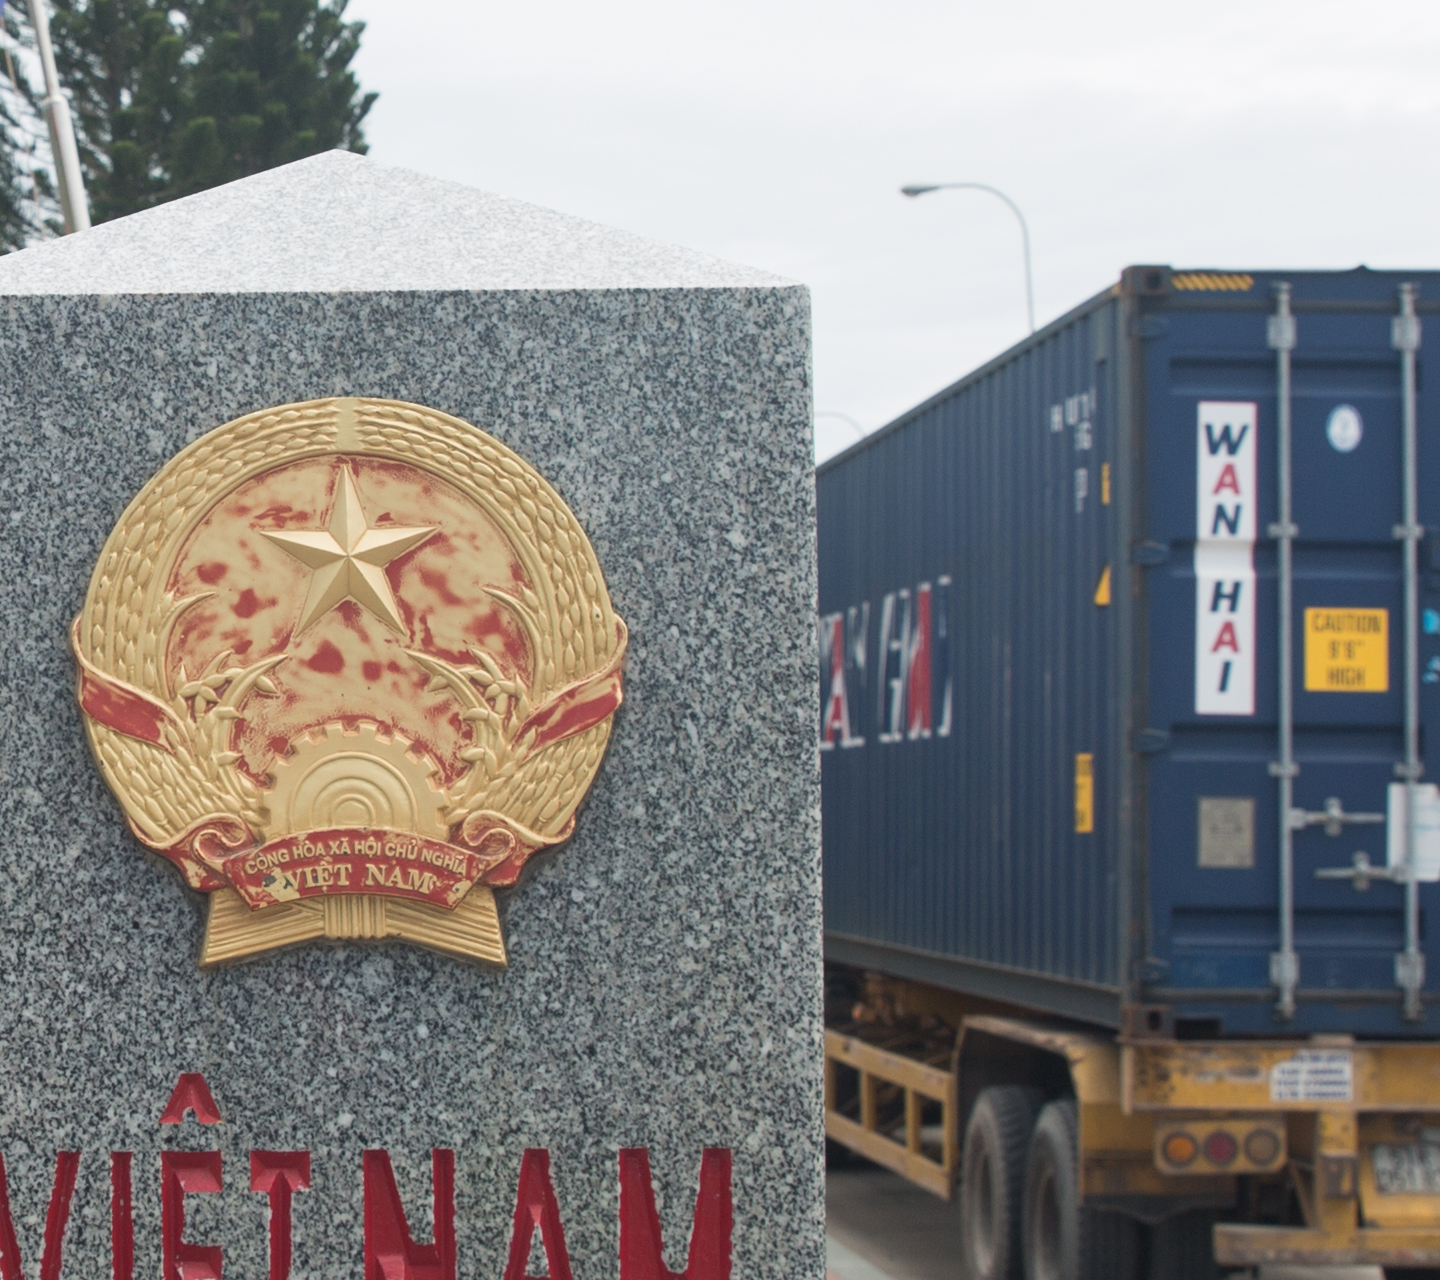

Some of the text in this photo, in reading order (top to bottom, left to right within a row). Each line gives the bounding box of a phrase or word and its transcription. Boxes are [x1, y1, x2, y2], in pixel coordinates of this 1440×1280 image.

[1205, 423, 1249, 693] WAN HAI
[1313, 613, 1381, 633] CAUTION
[1328, 666, 1366, 686] HIGH
[292, 840, 327, 860] HÒA
[328, 837, 351, 856] XÃ
[354, 836, 382, 859] HỘI
[384, 839, 418, 860] CHỦ
[421, 849, 467, 877] NGHĨA
[284, 860, 434, 895] VIỆT NAM
